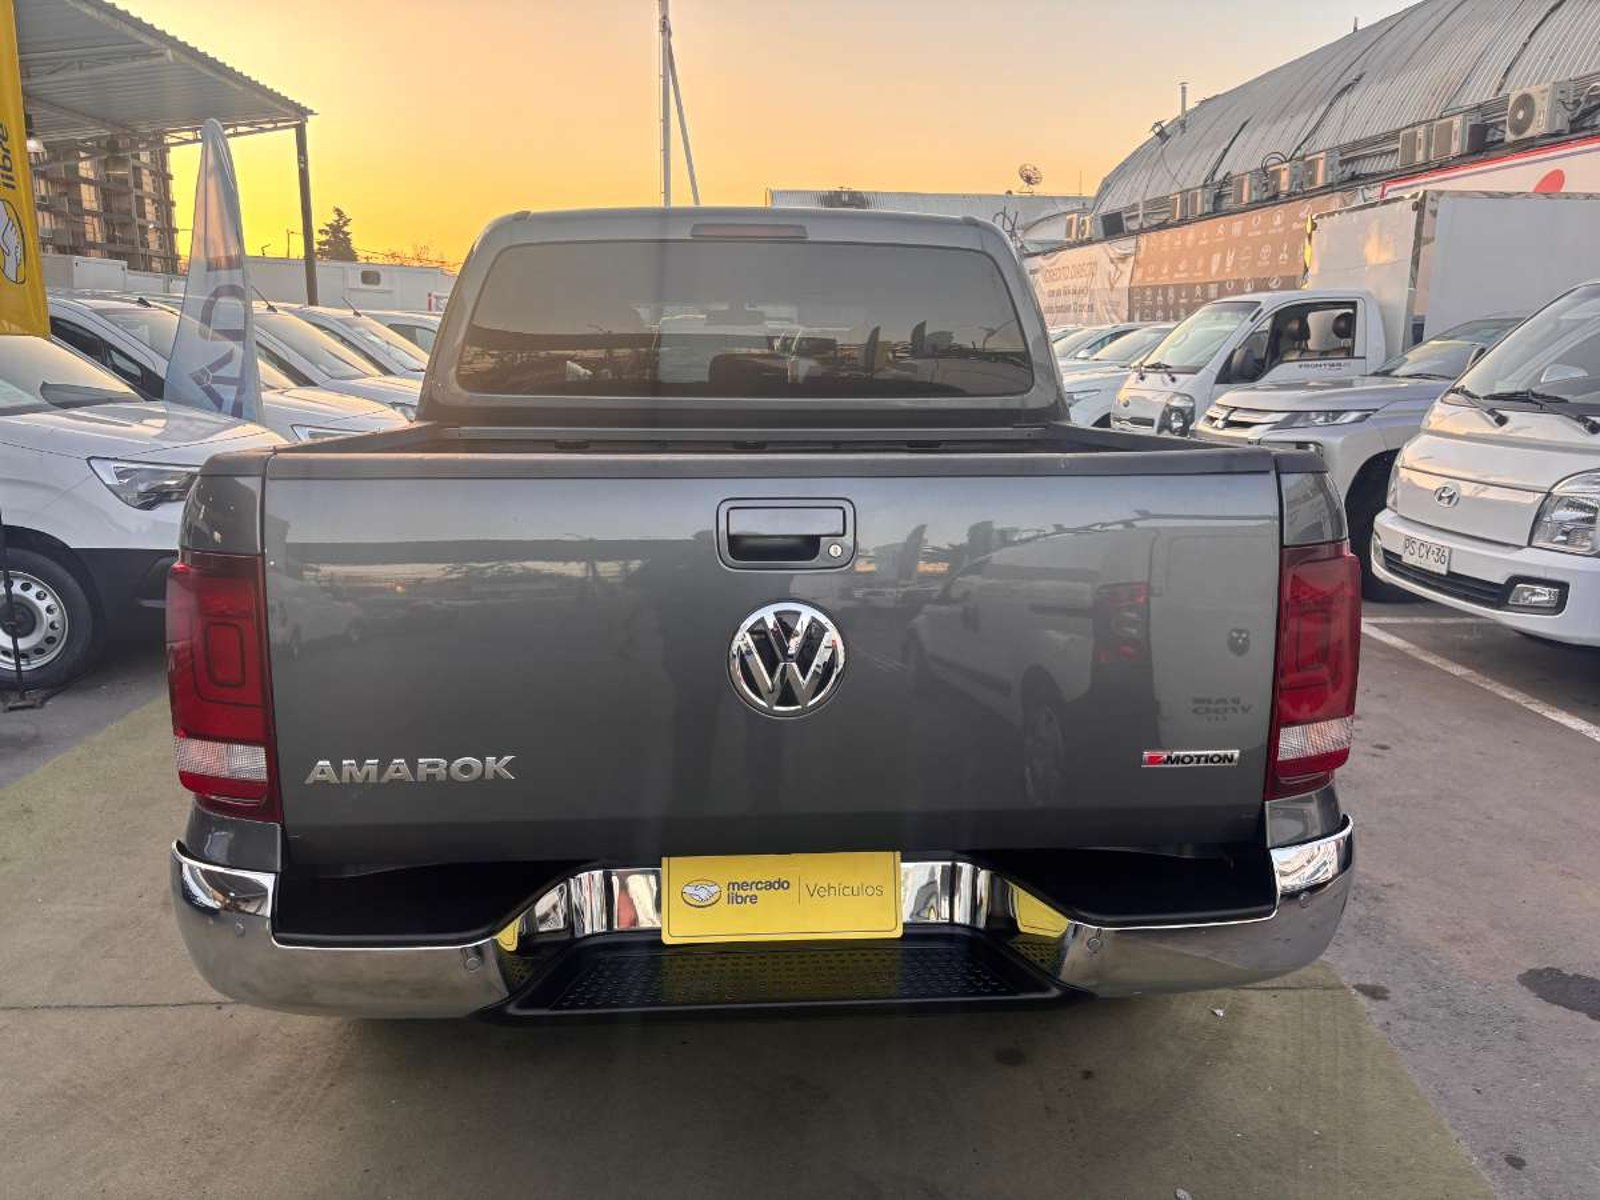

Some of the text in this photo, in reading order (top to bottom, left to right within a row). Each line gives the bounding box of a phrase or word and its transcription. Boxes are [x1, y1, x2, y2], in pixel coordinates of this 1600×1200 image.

[304, 755, 517, 785] AMAROK
[727, 877, 790, 893] mercado
[727, 893, 758, 906] libre
